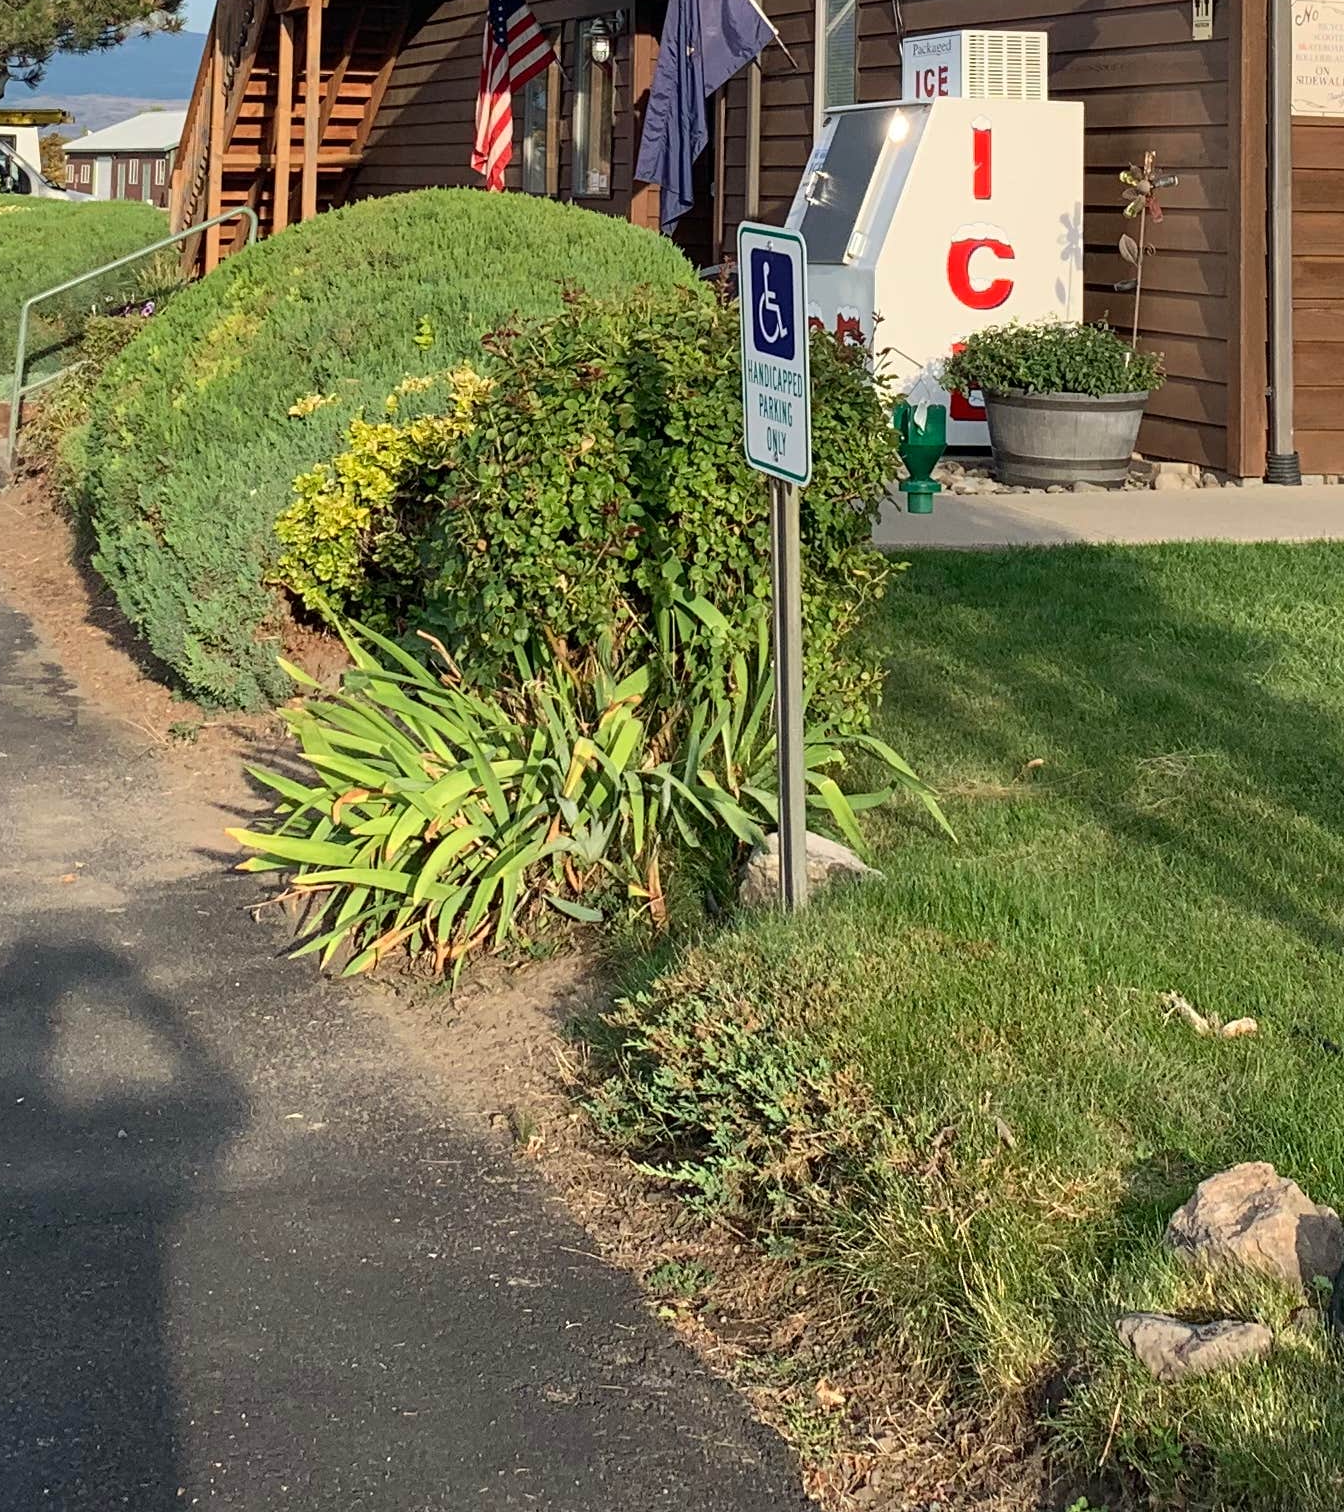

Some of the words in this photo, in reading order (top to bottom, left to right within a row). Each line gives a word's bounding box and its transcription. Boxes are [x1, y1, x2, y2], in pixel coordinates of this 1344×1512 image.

[1295, 5, 1319, 26] No
[913, 39, 952, 56] Packaged
[915, 65, 949, 99] ICE
[1315, 66, 1330, 75] ON
[747, 359, 803, 398] HANDICAPPED
[759, 393, 793, 427] PARKING
[766, 426, 787, 457] ONLY
